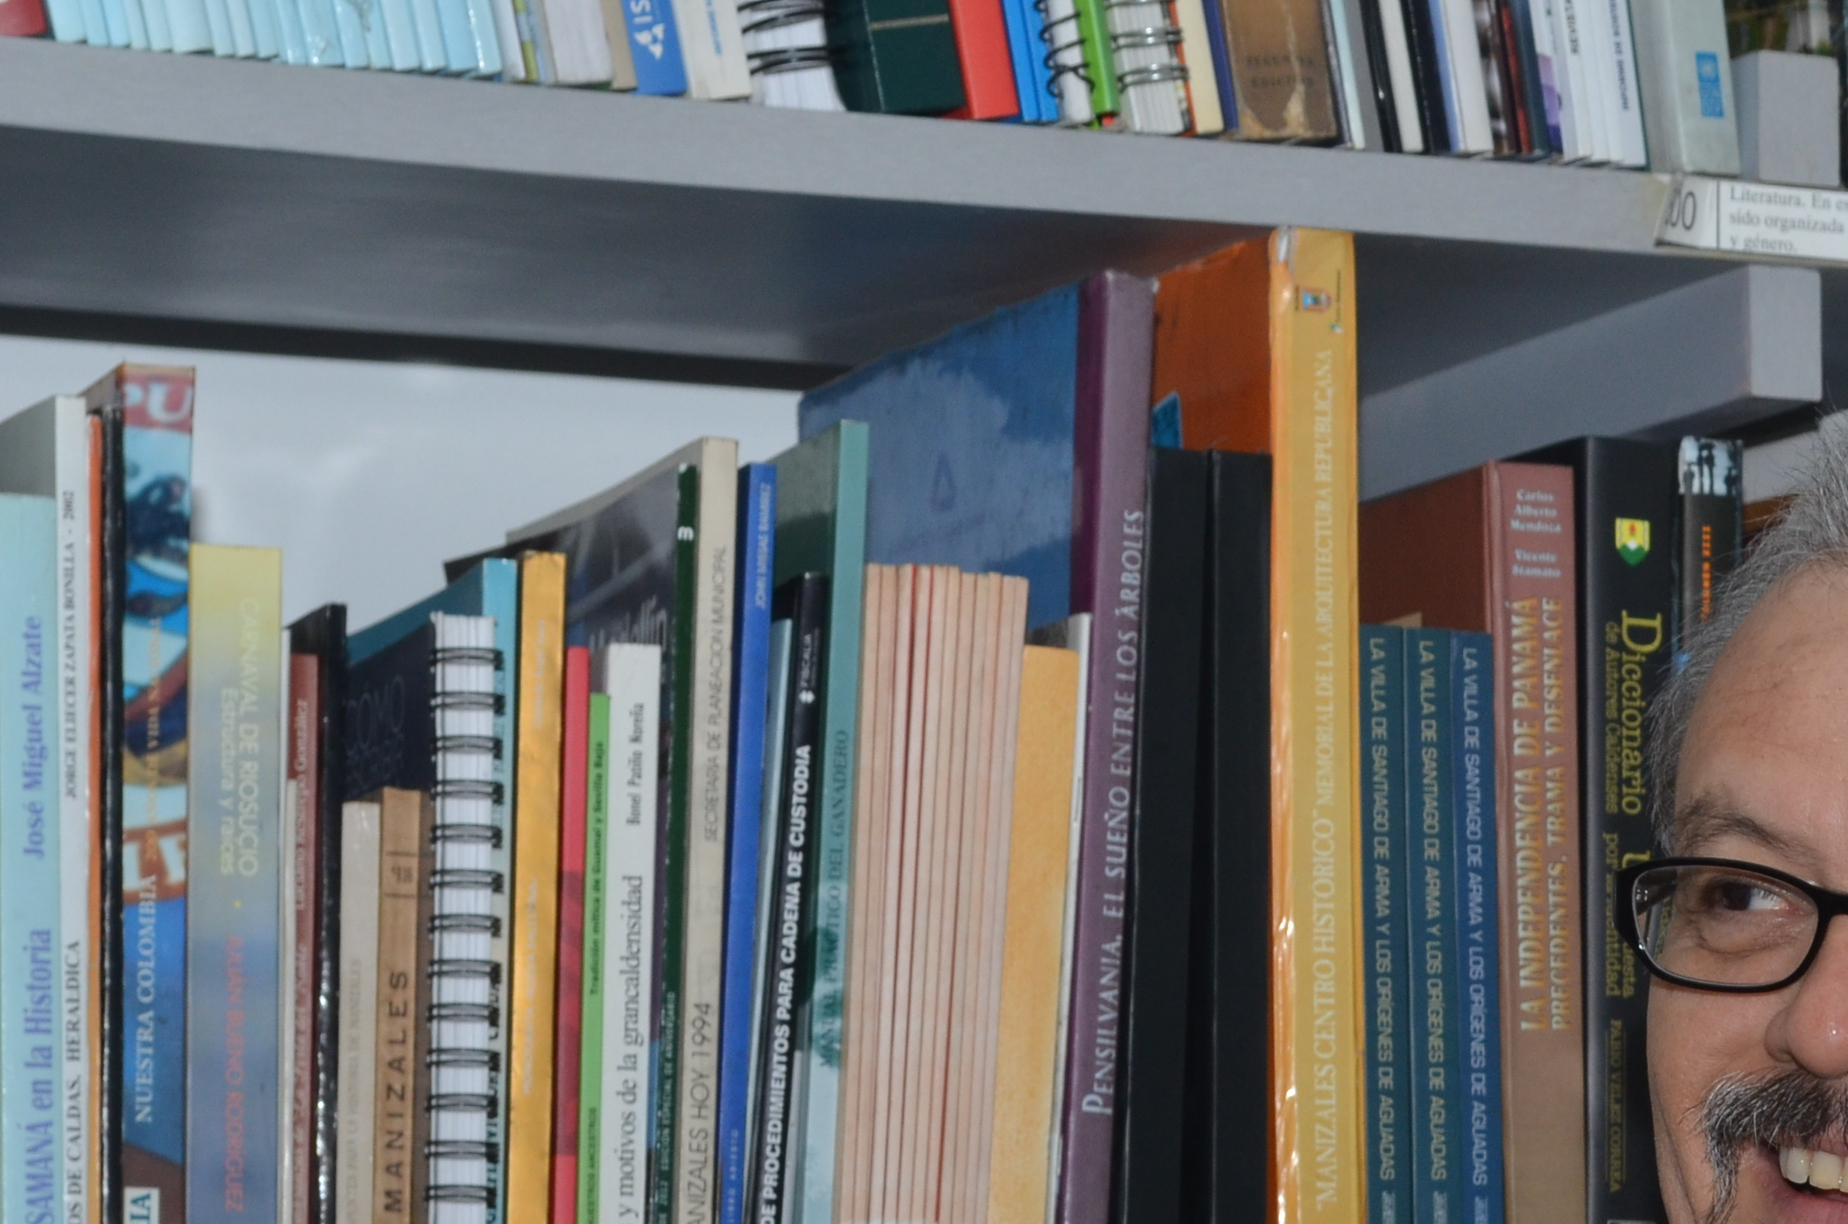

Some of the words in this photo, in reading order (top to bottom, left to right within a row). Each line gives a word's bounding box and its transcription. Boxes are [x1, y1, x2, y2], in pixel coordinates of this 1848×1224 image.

[1729, 187, 1806, 209] Literatura.
[1811, 192, 1831, 209] En
[1114, 509, 1143, 616] ÁRBOLES
[20, 615, 43, 691] Alzate
[237, 597, 259, 715] CARNAVAL
[1115, 630, 1138, 681] LOS
[1463, 648, 1479, 670] LA
[1503, 595, 1538, 710] PANAMÁ
[1540, 596, 1566, 733] DESENLACE
[1604, 621, 1622, 643] de
[1464, 674, 1480, 721] VILLA
[1604, 648, 1621, 718] Autores
[1619, 609, 1664, 816] Diccionario
[21, 695, 46, 788] Miguel
[238, 723, 259, 753] DE
[1109, 692, 1135, 777] ENTRE
[1464, 726, 1480, 748] DE
[1512, 719, 1539, 755] DE
[1543, 741, 1566, 755] Y
[1604, 723, 1621, 814] Caldenses
[22, 793, 45, 862] José
[237, 760, 259, 877] RIOSUCIO
[788, 745, 811, 847] CUSTODIA
[1464, 754, 1482, 839] SANTIAGO
[1544, 765, 1568, 846] TRAMA
[786, 851, 804, 878] DE
[1102, 785, 1131, 878] SUEÑO
[1467, 844, 1483, 867] DE
[1101, 891, 1124, 918] EL
[1468, 870, 1484, 925] ARMA
[1513, 766, 1546, 988] INDEPENDENCIA
[137, 875, 161, 1004] COLOMBIA
[780, 882, 801, 964] CADENA
[1469, 929, 1484, 943] Y
[1546, 854, 1573, 1031] PRECEDENTES.
[24, 928, 52, 1036] Historia
[616, 875, 645, 1046] grancaldensidad
[777, 968, 796, 1021] PARA
[1469, 947, 1485, 980] LOS
[689, 1002, 713, 1058] 1994
[1469, 984, 1490, 1068] ORÍGENES
[1520, 1000, 1547, 1031] LA
[1609, 1018, 1623, 1067] FABIO
[26, 1044, 52, 1069] la
[136, 1012, 157, 1123] NUESTRA
[617, 1053, 638, 1072] la
[1471, 1073, 1487, 1097] DE
[33, 1075, 53, 1110] en
[385, 970, 408, 1214] MANIZALES
[615, 1079, 637, 1105] de
[688, 1068, 712, 1120] HOY
[761, 1024, 792, 1200] PROCEDIMIENTOS
[615, 1111, 636, 1197] motivos
[1471, 1100, 1488, 1185] AGUADAS
[1609, 1126, 1623, 1193] CORREA
[616, 1200, 637, 1218] y
